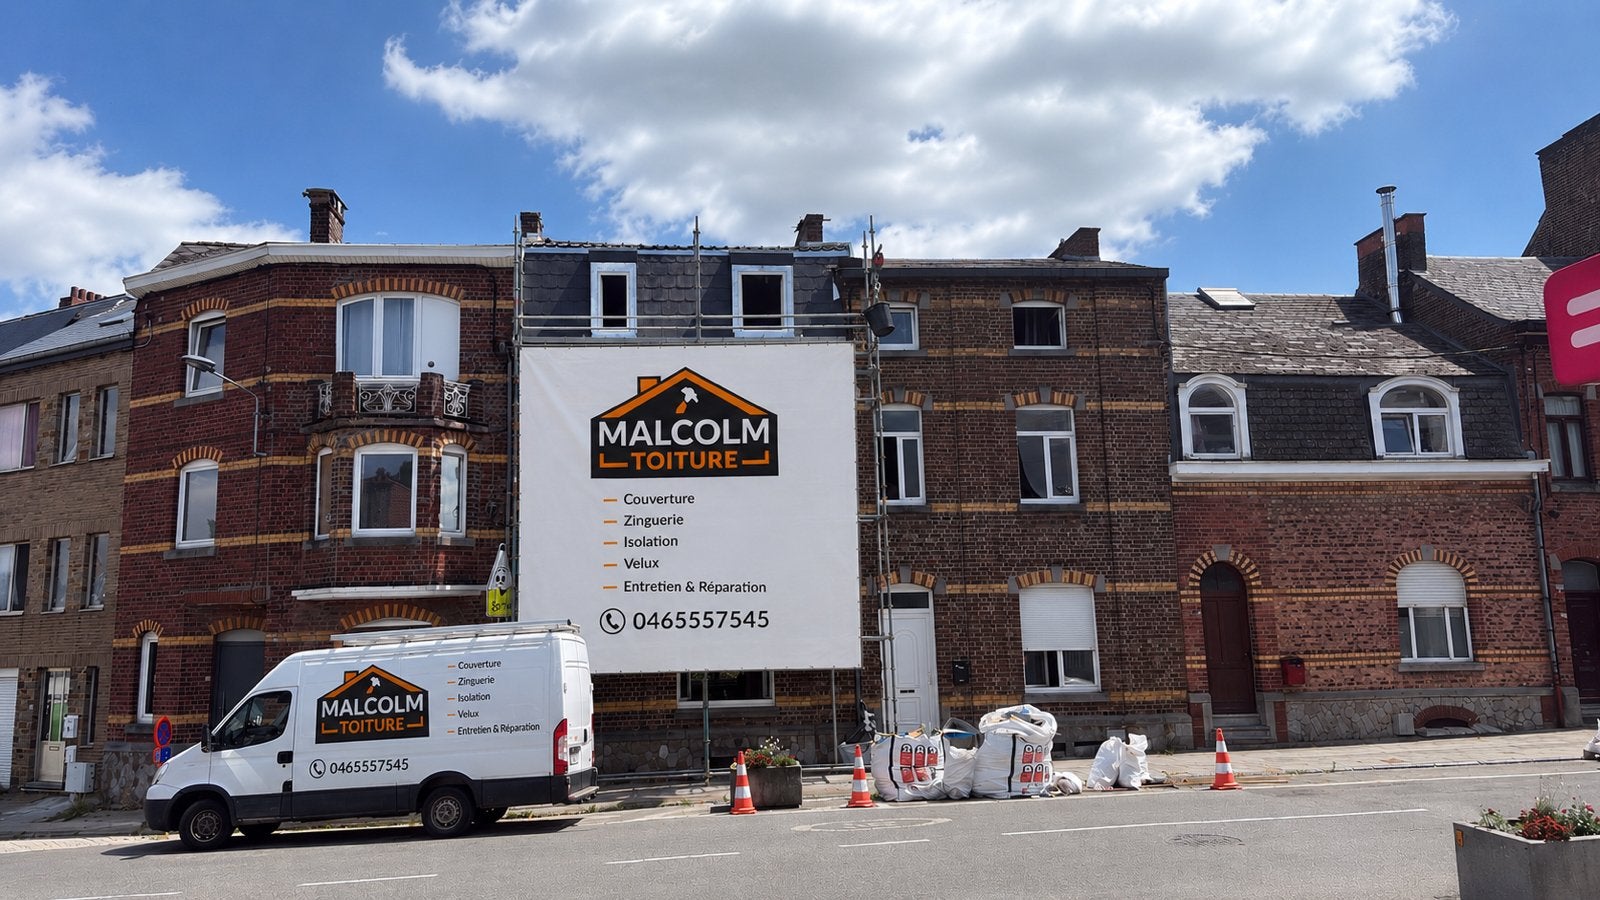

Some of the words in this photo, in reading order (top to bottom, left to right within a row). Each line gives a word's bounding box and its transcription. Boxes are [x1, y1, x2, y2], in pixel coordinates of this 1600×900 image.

[598, 418, 770, 447] MALCOLM
[630, 450, 739, 471] TOITURE
[623, 493, 695, 506] Couverture
[623, 514, 684, 529] Zinguerie
[623, 535, 679, 549] Isolation
[623, 557, 660, 570] Velux
[623, 580, 682, 593] Entretien
[684, 580, 696, 593] &
[698, 580, 767, 595] Réparation
[632, 610, 770, 631] 0465557545
[457, 659, 502, 670] Couverture
[457, 675, 496, 687] Zinguerie
[457, 692, 491, 702] Isolation
[321, 693, 424, 718] MALCOLM
[457, 709, 480, 719] Velux
[339, 717, 405, 735] TOITURE
[457, 725, 492, 736] Entretien
[492, 724, 500, 734] &
[500, 722, 541, 735] Réparation
[329, 758, 410, 775] 0465557545
